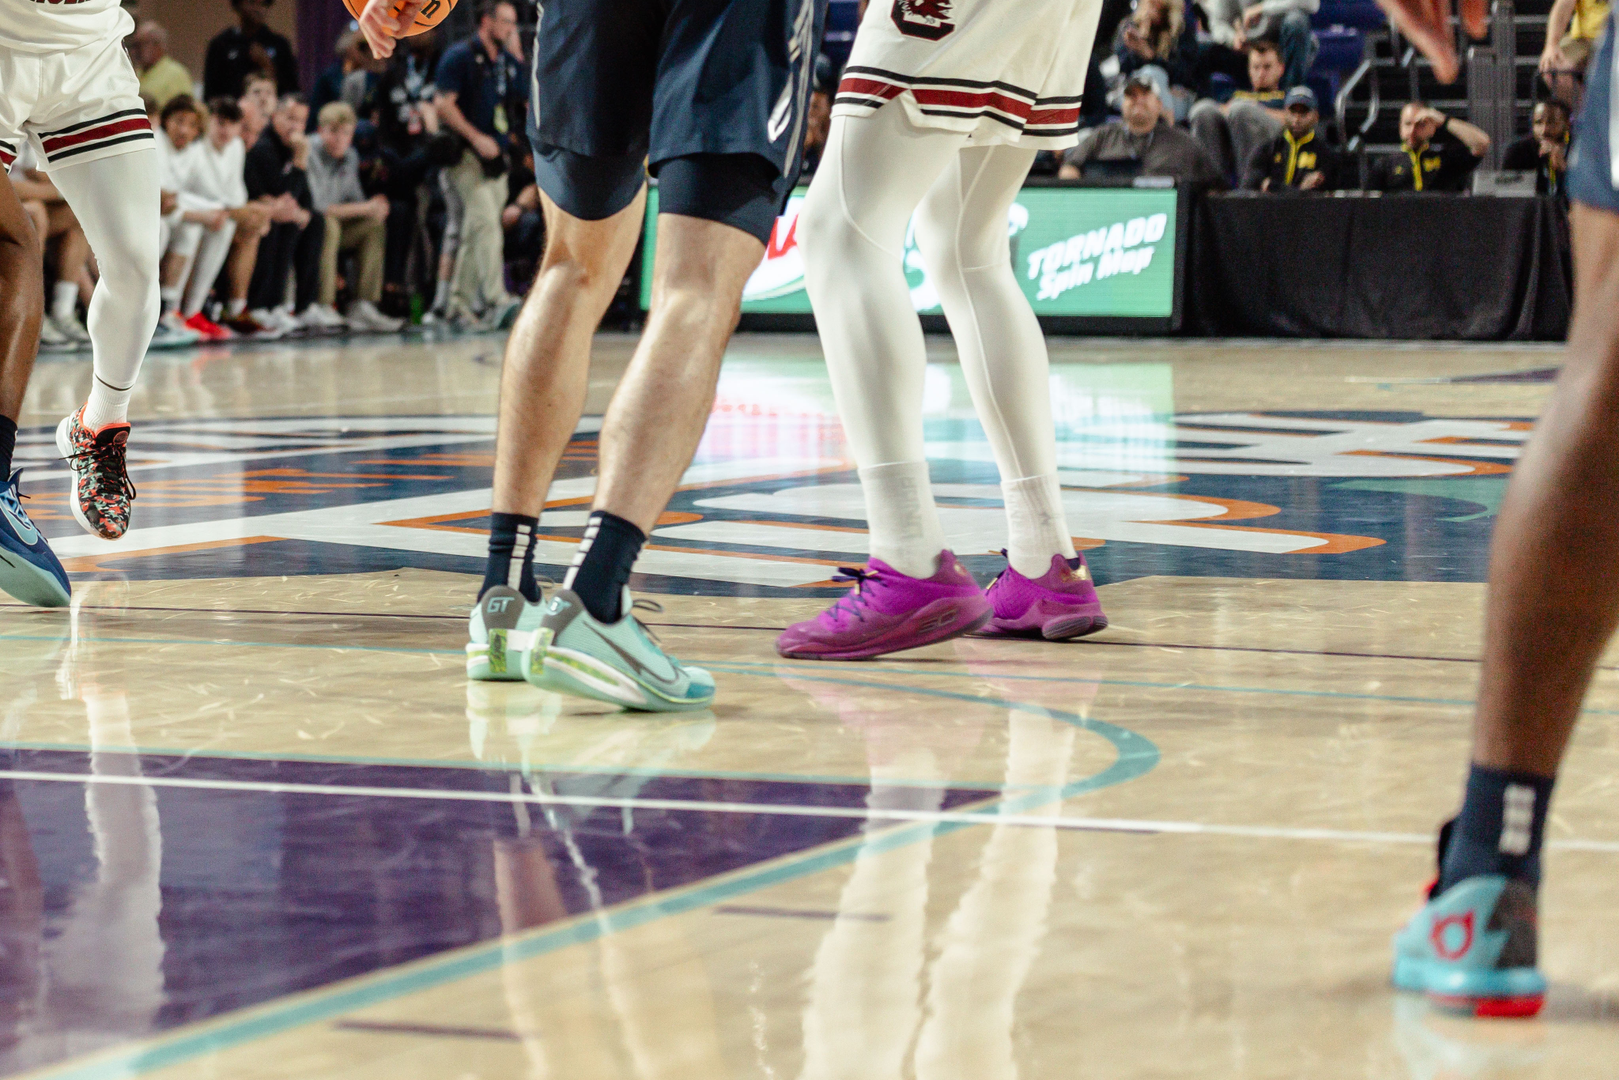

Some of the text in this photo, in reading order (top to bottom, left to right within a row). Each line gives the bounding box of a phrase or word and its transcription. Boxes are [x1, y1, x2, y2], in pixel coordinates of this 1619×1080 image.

[1026, 212, 1168, 281] TORNADO
[1036, 245, 1156, 302] Spin Mop
[486, 596, 516, 614] GT
